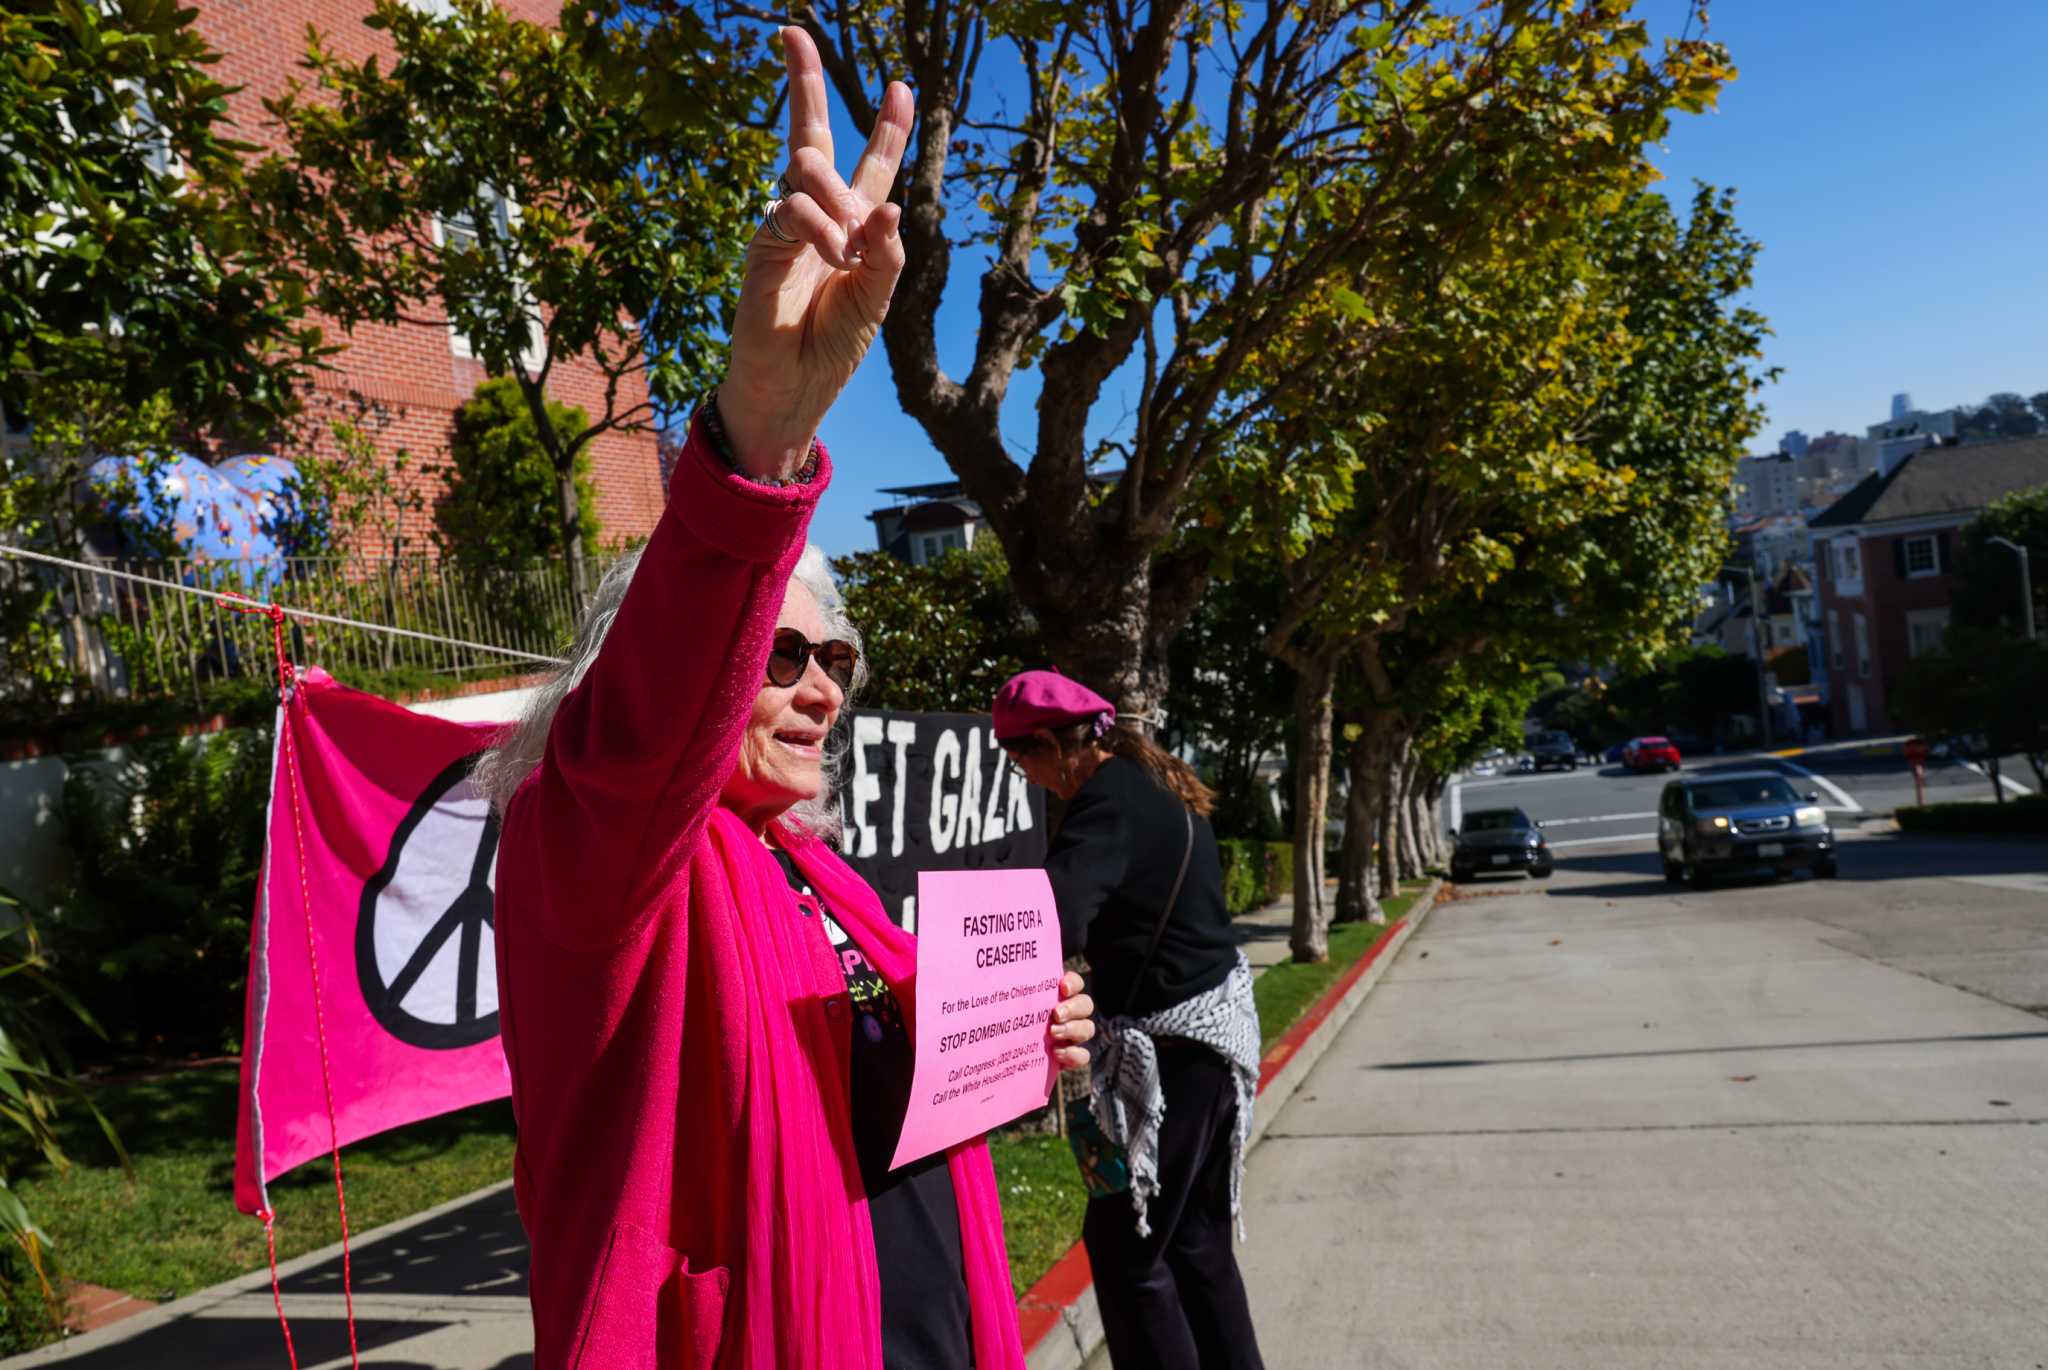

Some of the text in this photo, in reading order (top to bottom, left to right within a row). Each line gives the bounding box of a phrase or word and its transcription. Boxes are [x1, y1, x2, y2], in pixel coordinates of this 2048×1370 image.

[929, 726, 1033, 854] GAZA
[964, 909, 1043, 937] FASTING FOR A
[976, 940, 1037, 968] CEASEFIRE
[942, 1001, 955, 1015] For
[957, 999, 969, 1011] the
[971, 995, 988, 1008] Love
[990, 992, 997, 1004] of
[999, 990, 1009, 1002] the
[1010, 986, 1036, 999] Children
[1037, 982, 1044, 993] of
[940, 1008, 1050, 1053] STOP BOMBING GAZA NO
[948, 1068, 962, 1082] Call
[932, 1090, 948, 1106] Call
[949, 1086, 960, 1100] the
[962, 1080, 981, 1094] White
